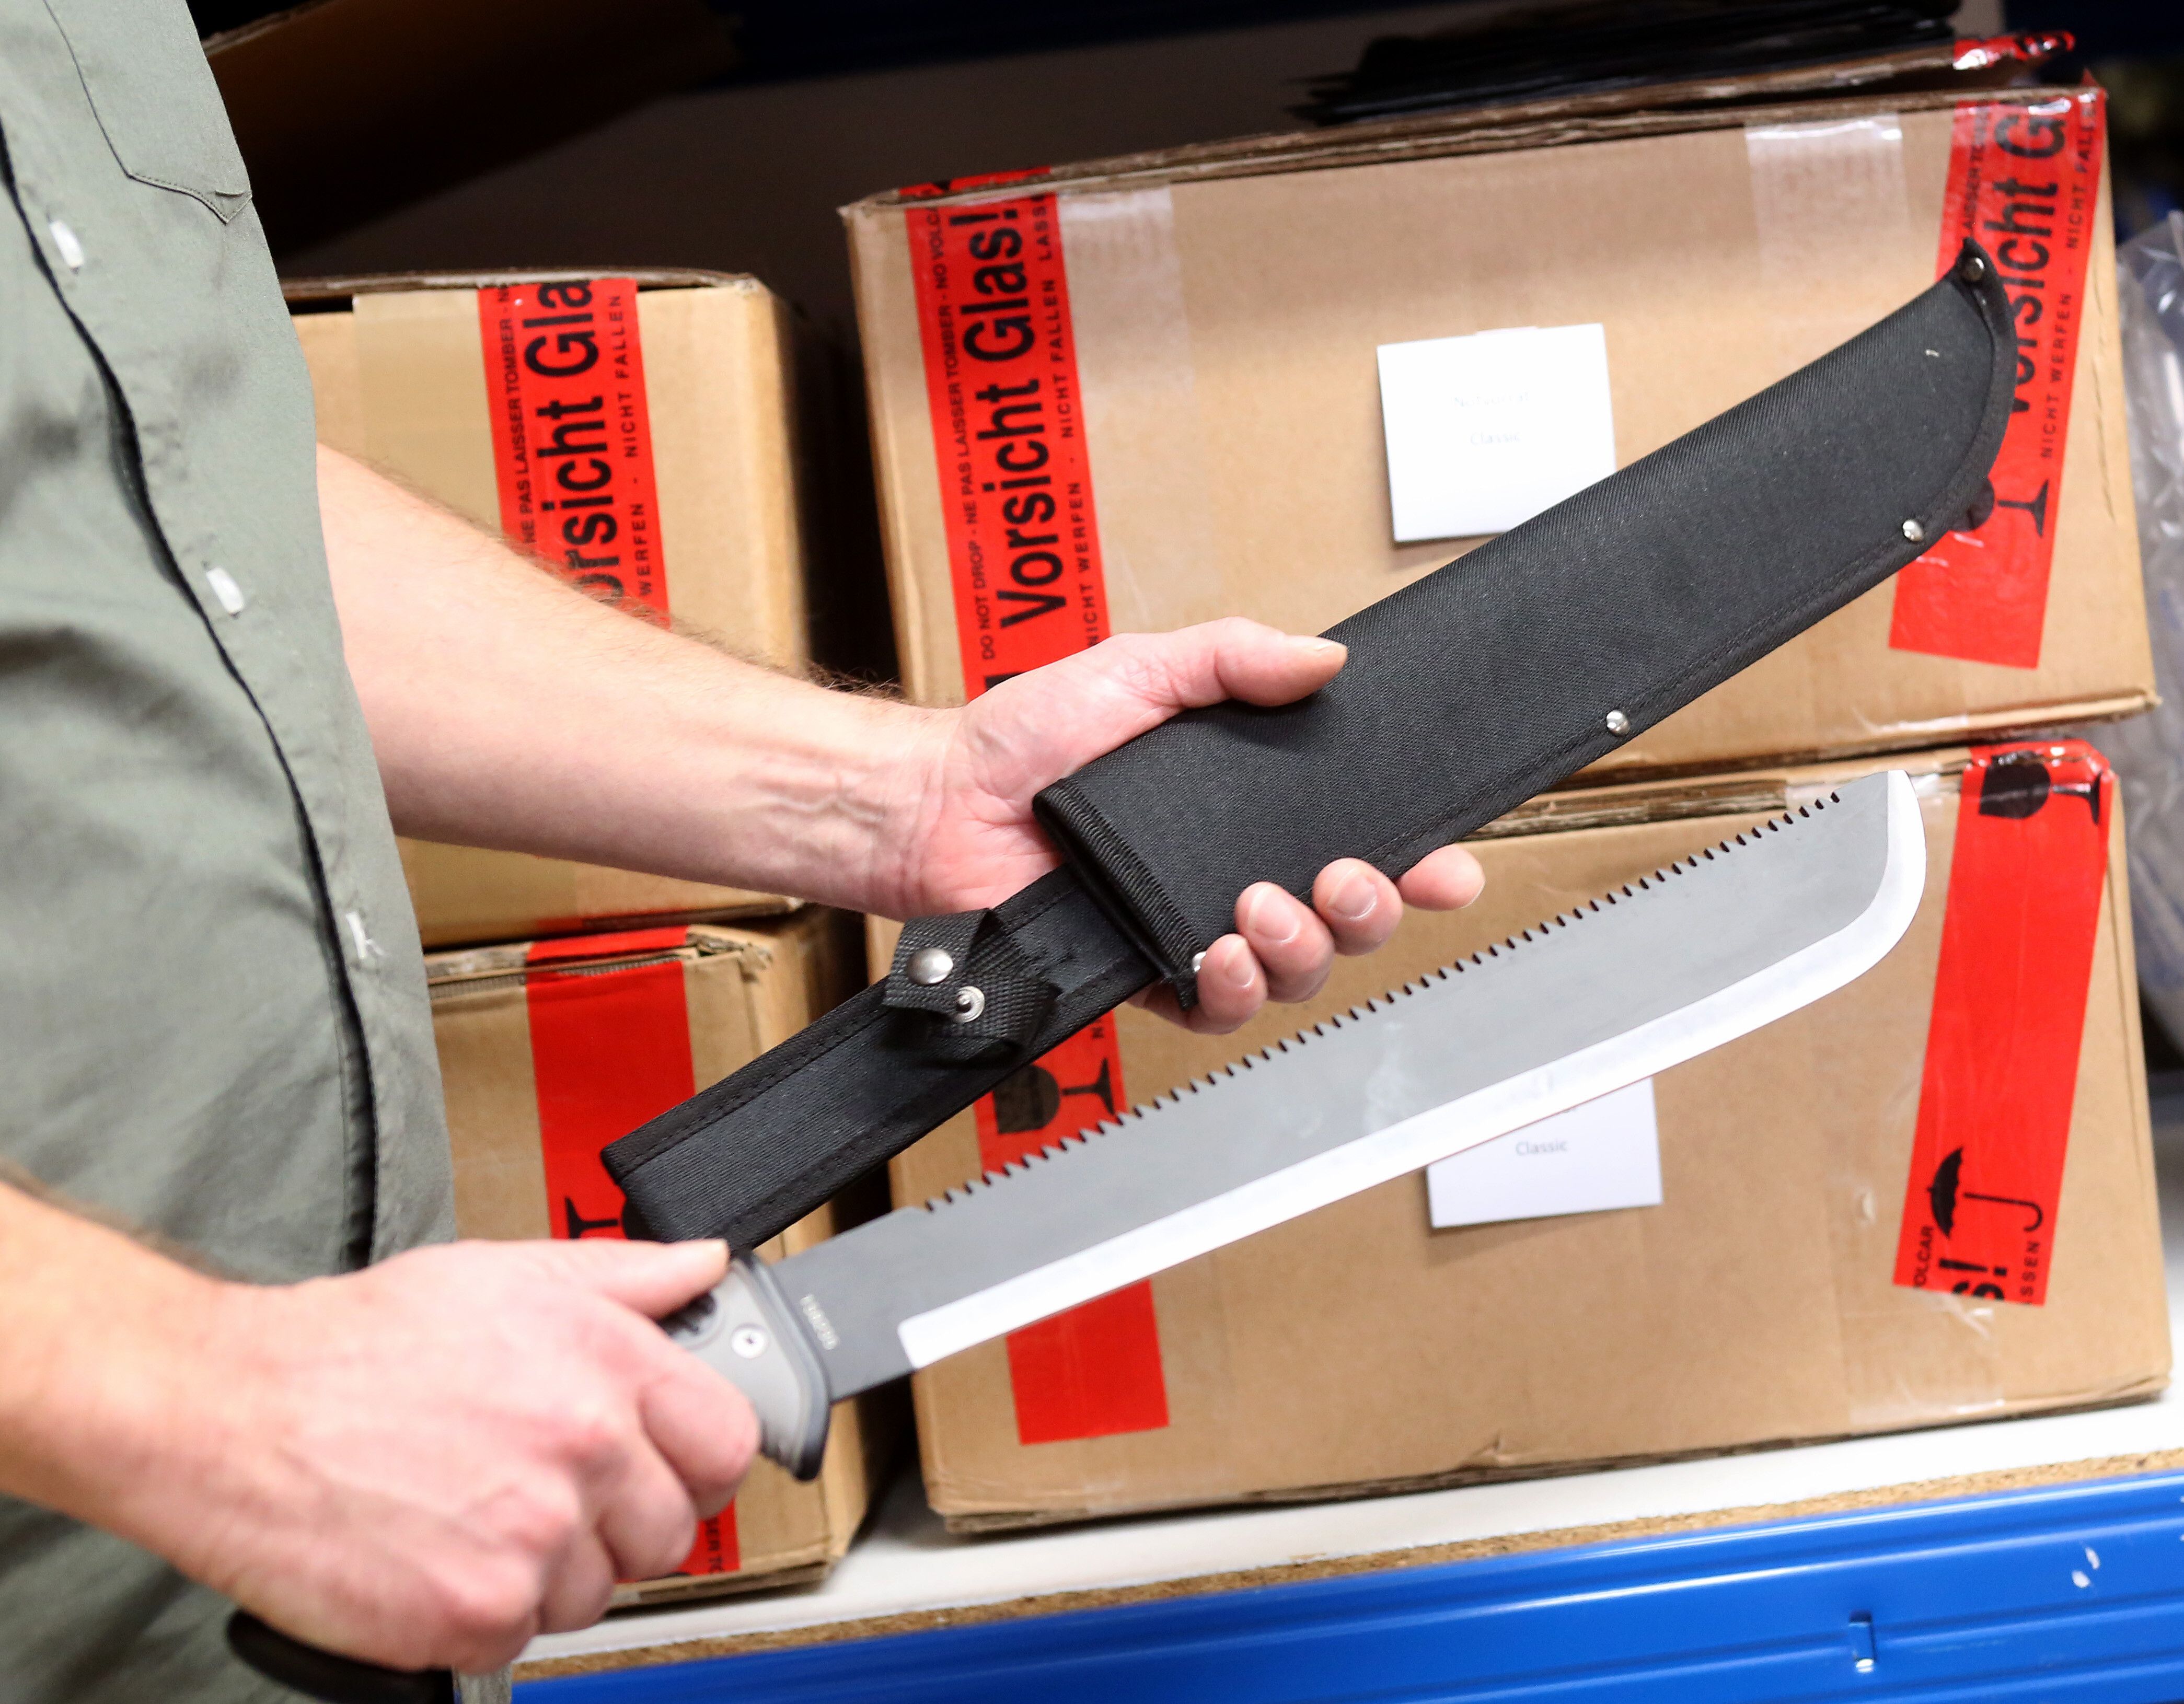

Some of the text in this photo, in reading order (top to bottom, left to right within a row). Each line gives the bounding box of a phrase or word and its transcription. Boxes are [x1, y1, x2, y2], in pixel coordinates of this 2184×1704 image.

[932, 262, 948, 289] NO
[499, 318, 520, 393] TOMBER
[608, 294, 630, 379] FALLEN
[938, 304, 958, 379] TOMBER
[1042, 279, 1065, 362] FALLEN
[2041, 393, 2059, 459] NICHT
[2050, 294, 2071, 383] WERFEN
[2066, 183, 2087, 249] NICHT
[507, 398, 529, 475] LAISSER
[617, 391, 639, 458] NICHT
[948, 382, 970, 457] LAISSER
[949, 208, 1067, 629] Vorsicht Glas!
[1053, 373, 1074, 438] NICHT
[516, 479, 533, 514] PAS
[536, 395, 625, 606] orsicht
[958, 462, 974, 496] PAS
[963, 501, 978, 525] NE
[630, 502, 653, 596] WERFEN
[968, 540, 987, 589] DROP
[1067, 482, 1091, 573] WERFEN
[975, 596, 991, 630] NOT
[980, 634, 996, 660] DO
[1515, 1139, 1568, 1156] Classic
